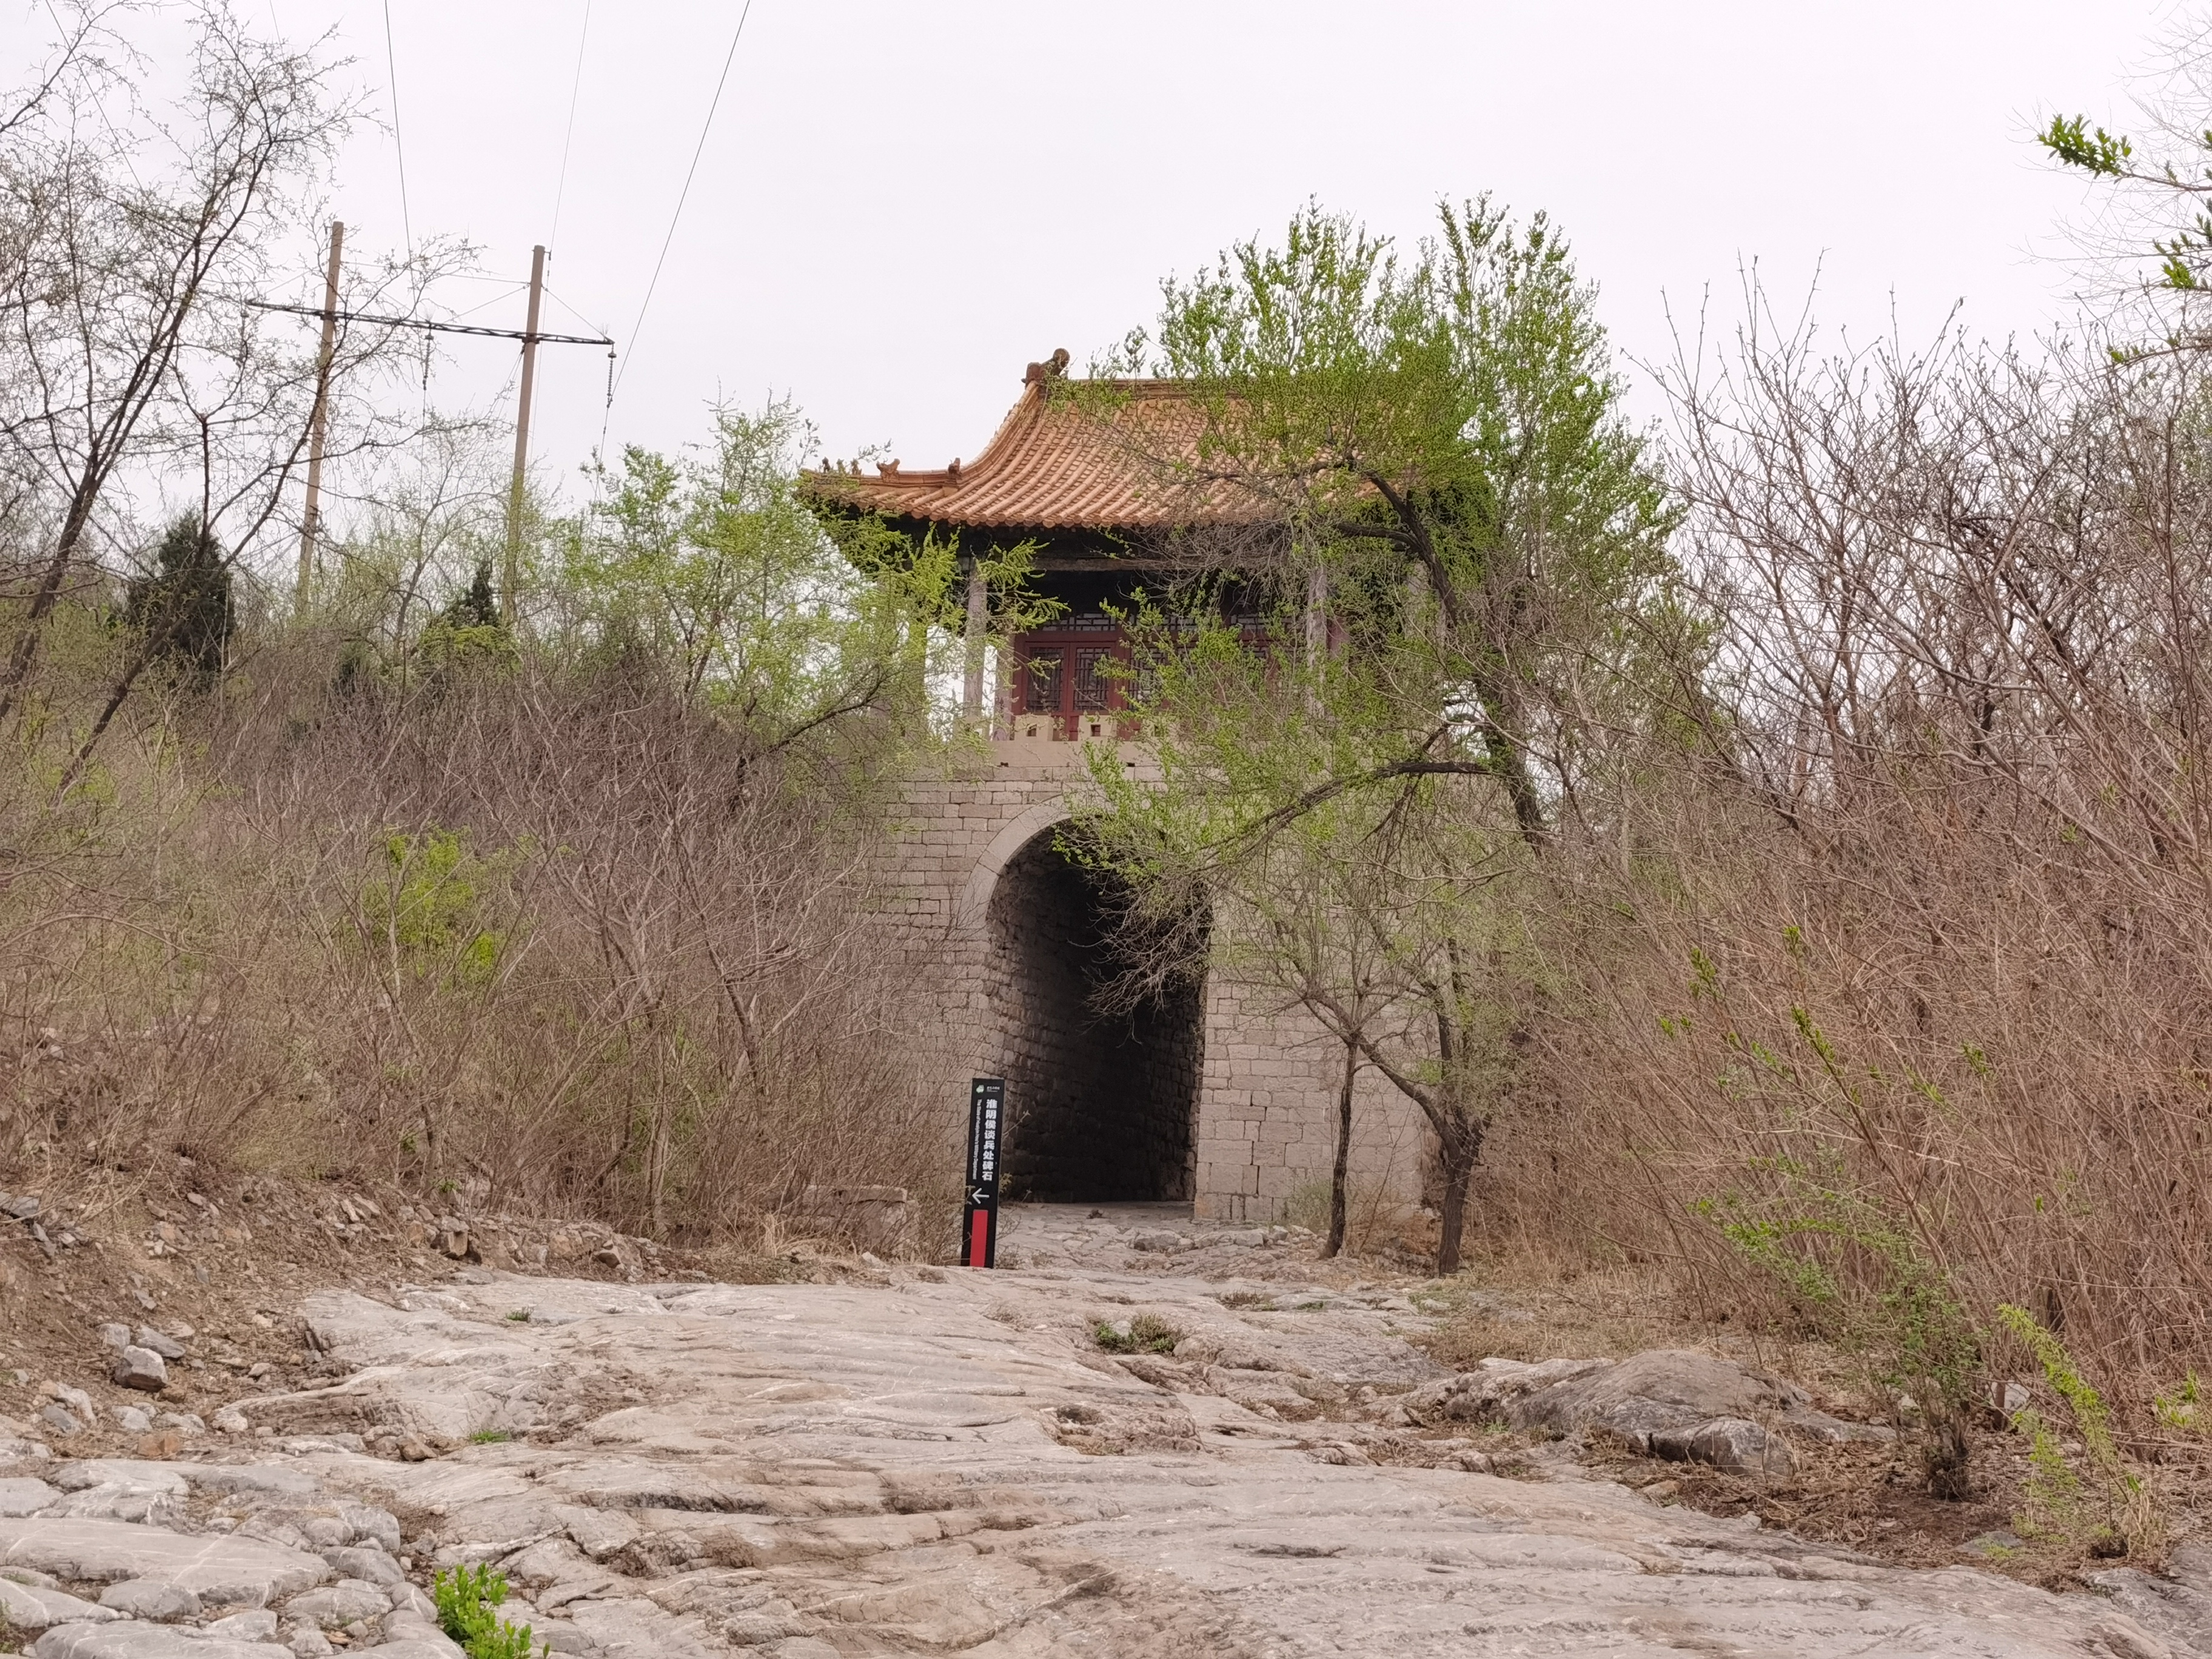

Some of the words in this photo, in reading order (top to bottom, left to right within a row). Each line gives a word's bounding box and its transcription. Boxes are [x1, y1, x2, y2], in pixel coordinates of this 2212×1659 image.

[982, 1099, 997, 1181] 淮阴侯谈兵处碑石
